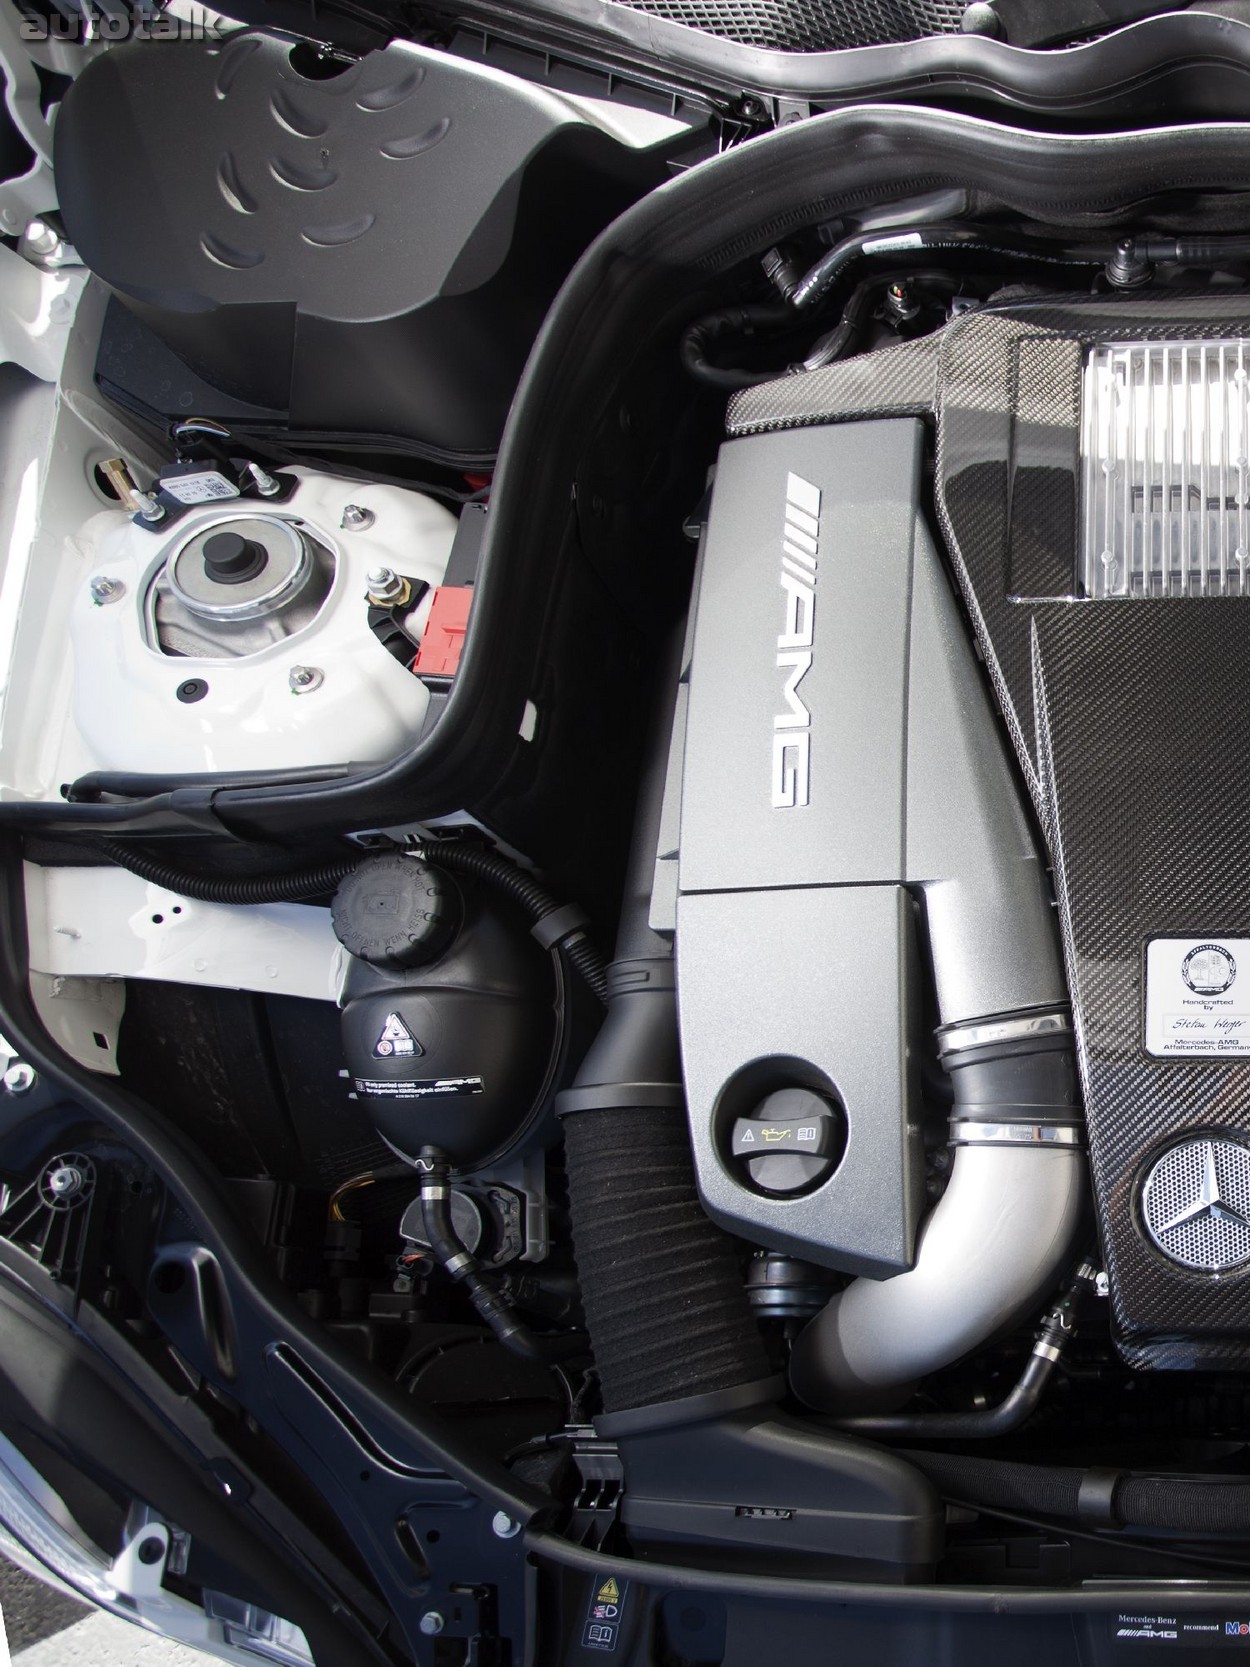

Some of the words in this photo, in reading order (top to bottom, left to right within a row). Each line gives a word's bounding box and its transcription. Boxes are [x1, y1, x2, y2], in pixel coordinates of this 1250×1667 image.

[772, 572, 815, 809] AMG
[408, 909, 425, 931] HEISS
[1118, 1614, 1177, 1625] Mercedes-Benz
[1138, 1630, 1178, 1639] AMG
